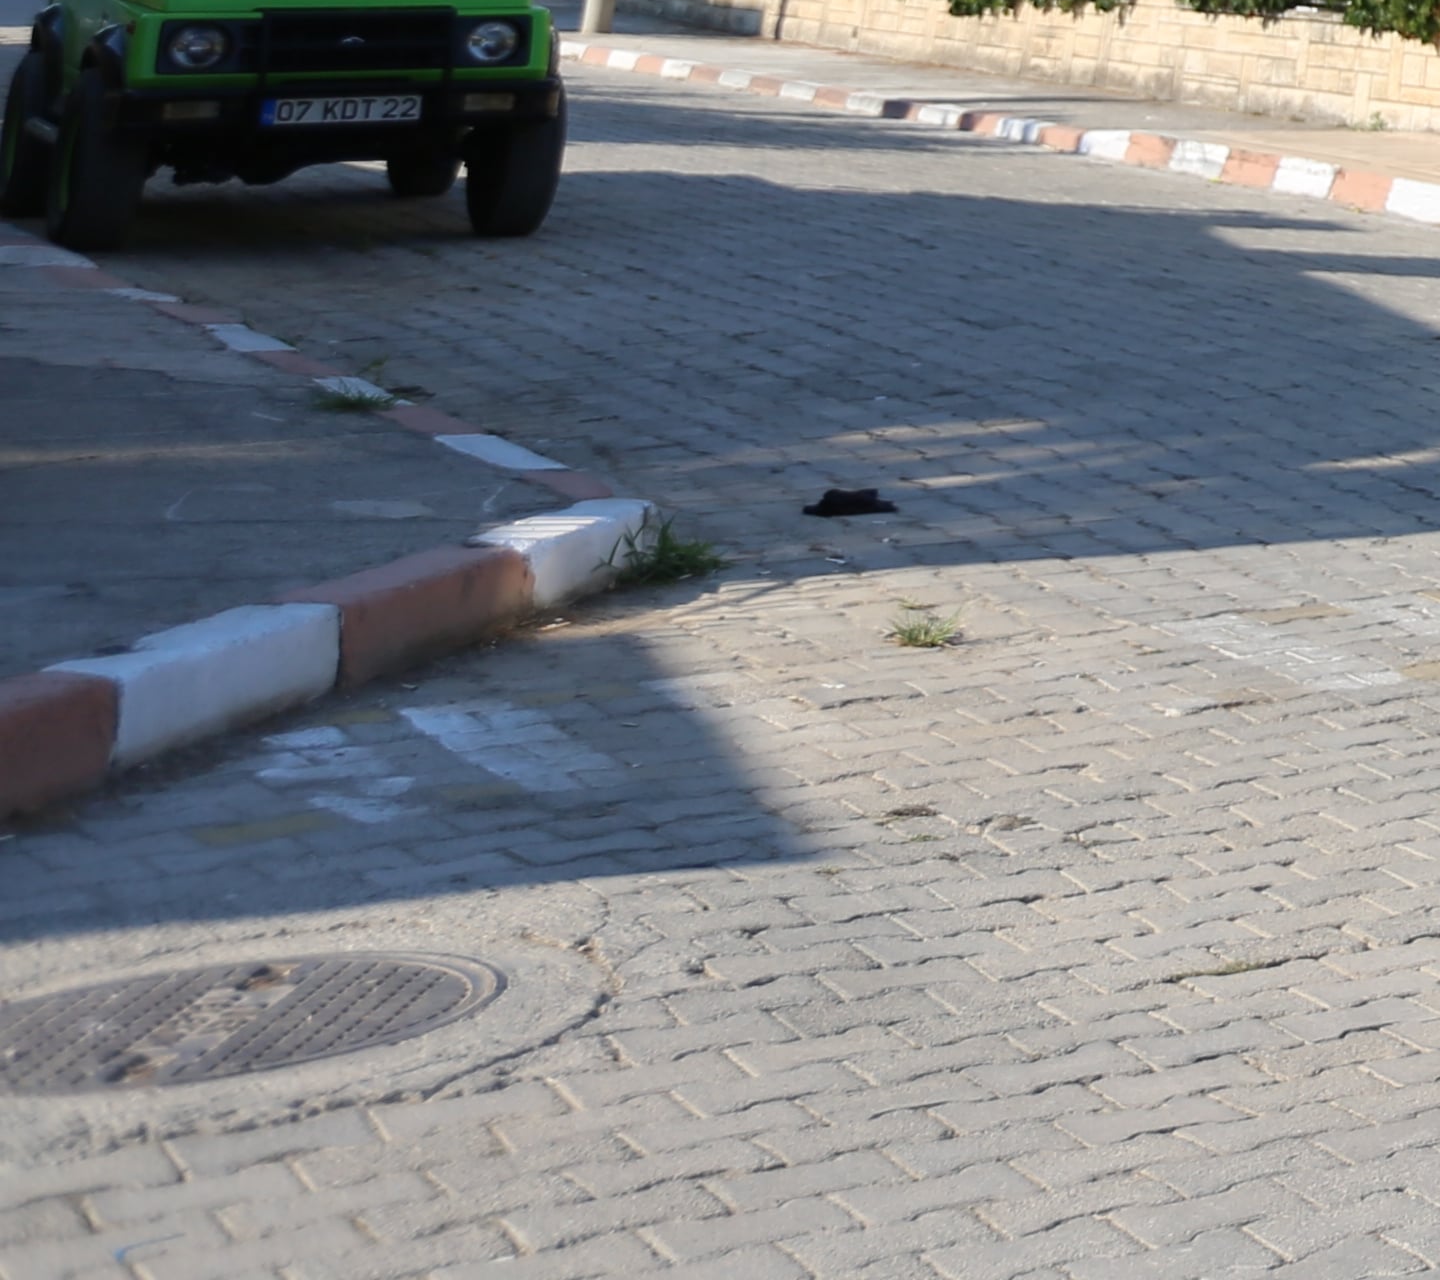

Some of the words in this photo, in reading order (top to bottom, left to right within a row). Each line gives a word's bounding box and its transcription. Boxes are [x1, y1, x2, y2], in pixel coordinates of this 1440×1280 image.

[276, 101, 313, 122] 07
[323, 99, 376, 120] KDT
[382, 98, 418, 119] 22
